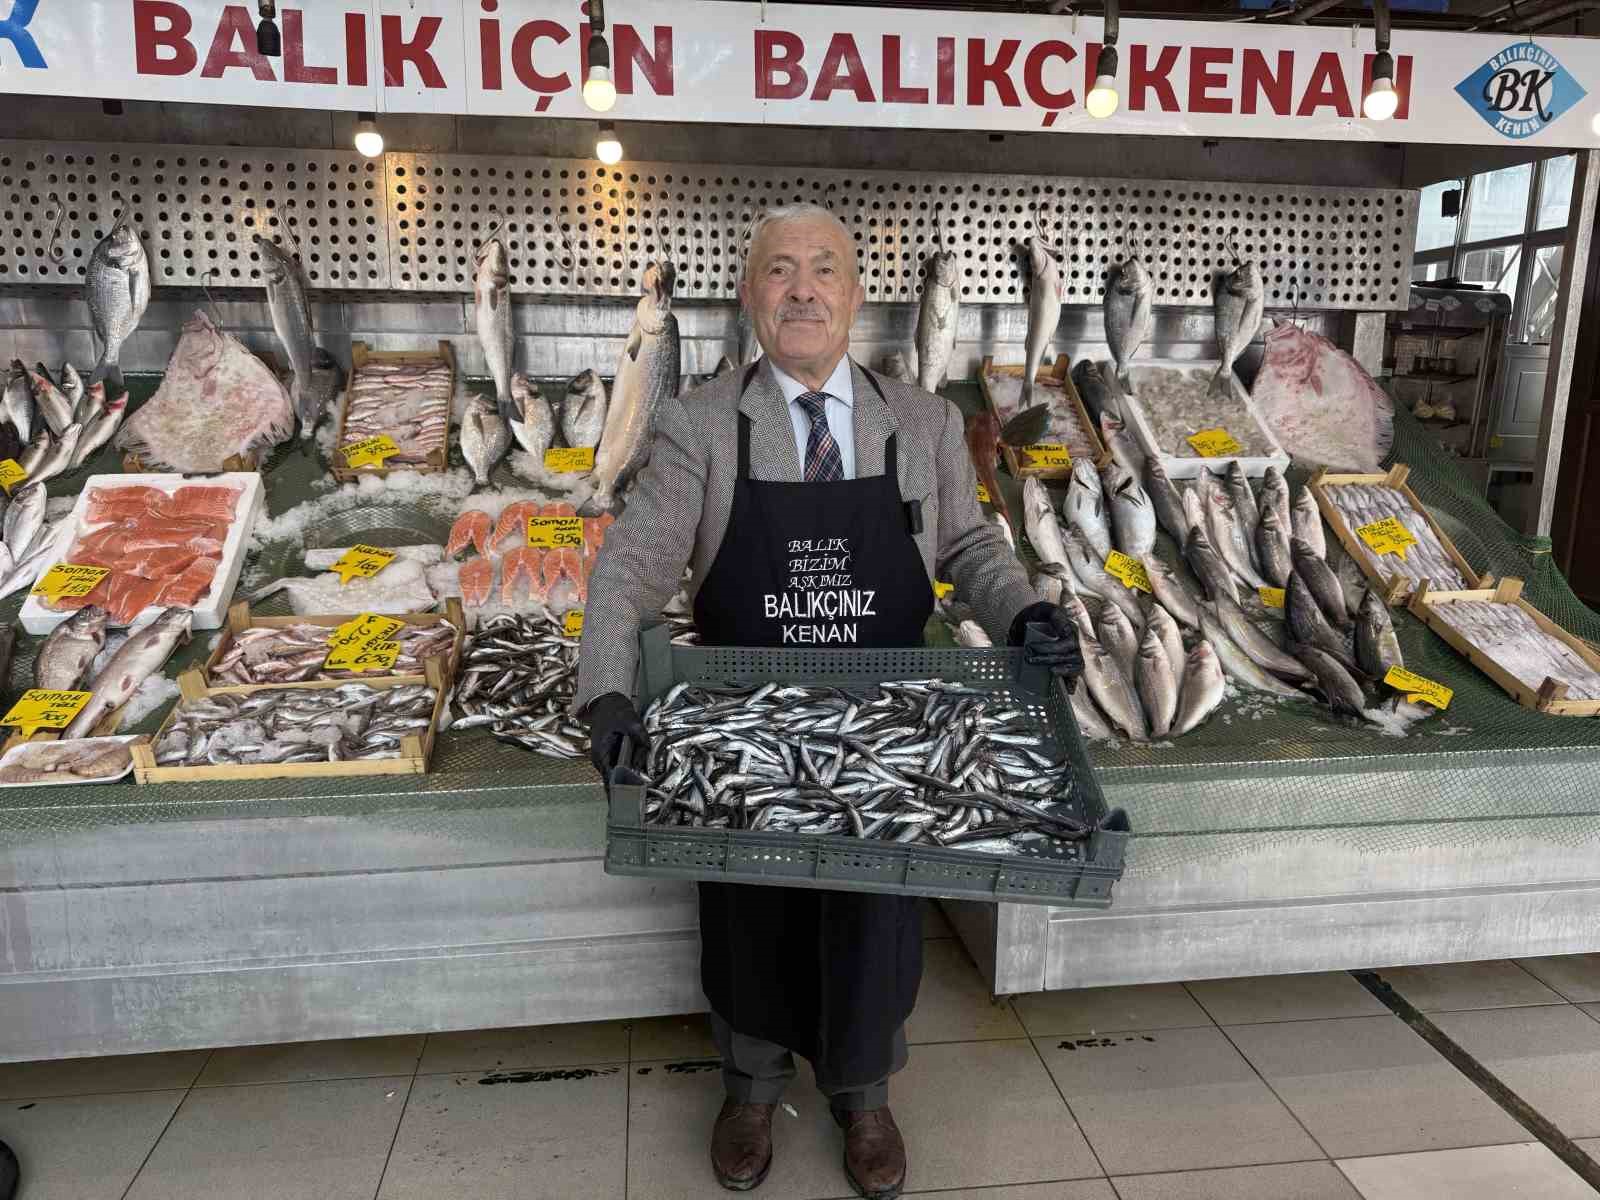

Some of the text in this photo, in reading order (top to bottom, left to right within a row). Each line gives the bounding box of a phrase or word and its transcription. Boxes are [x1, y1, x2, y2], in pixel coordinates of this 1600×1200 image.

[133, 0, 448, 89] BALIK
[479, 0, 675, 112] İÇİN
[753, 30, 1105, 127] BALIKÇI
[1482, 68, 1556, 122] BK
[1495, 117, 1540, 136] KENAN
[787, 538, 850, 556] BALIK
[788, 553, 849, 573] BİZİM
[763, 590, 876, 621] BALIKÇINIZ
[782, 623, 857, 643] KENAN
